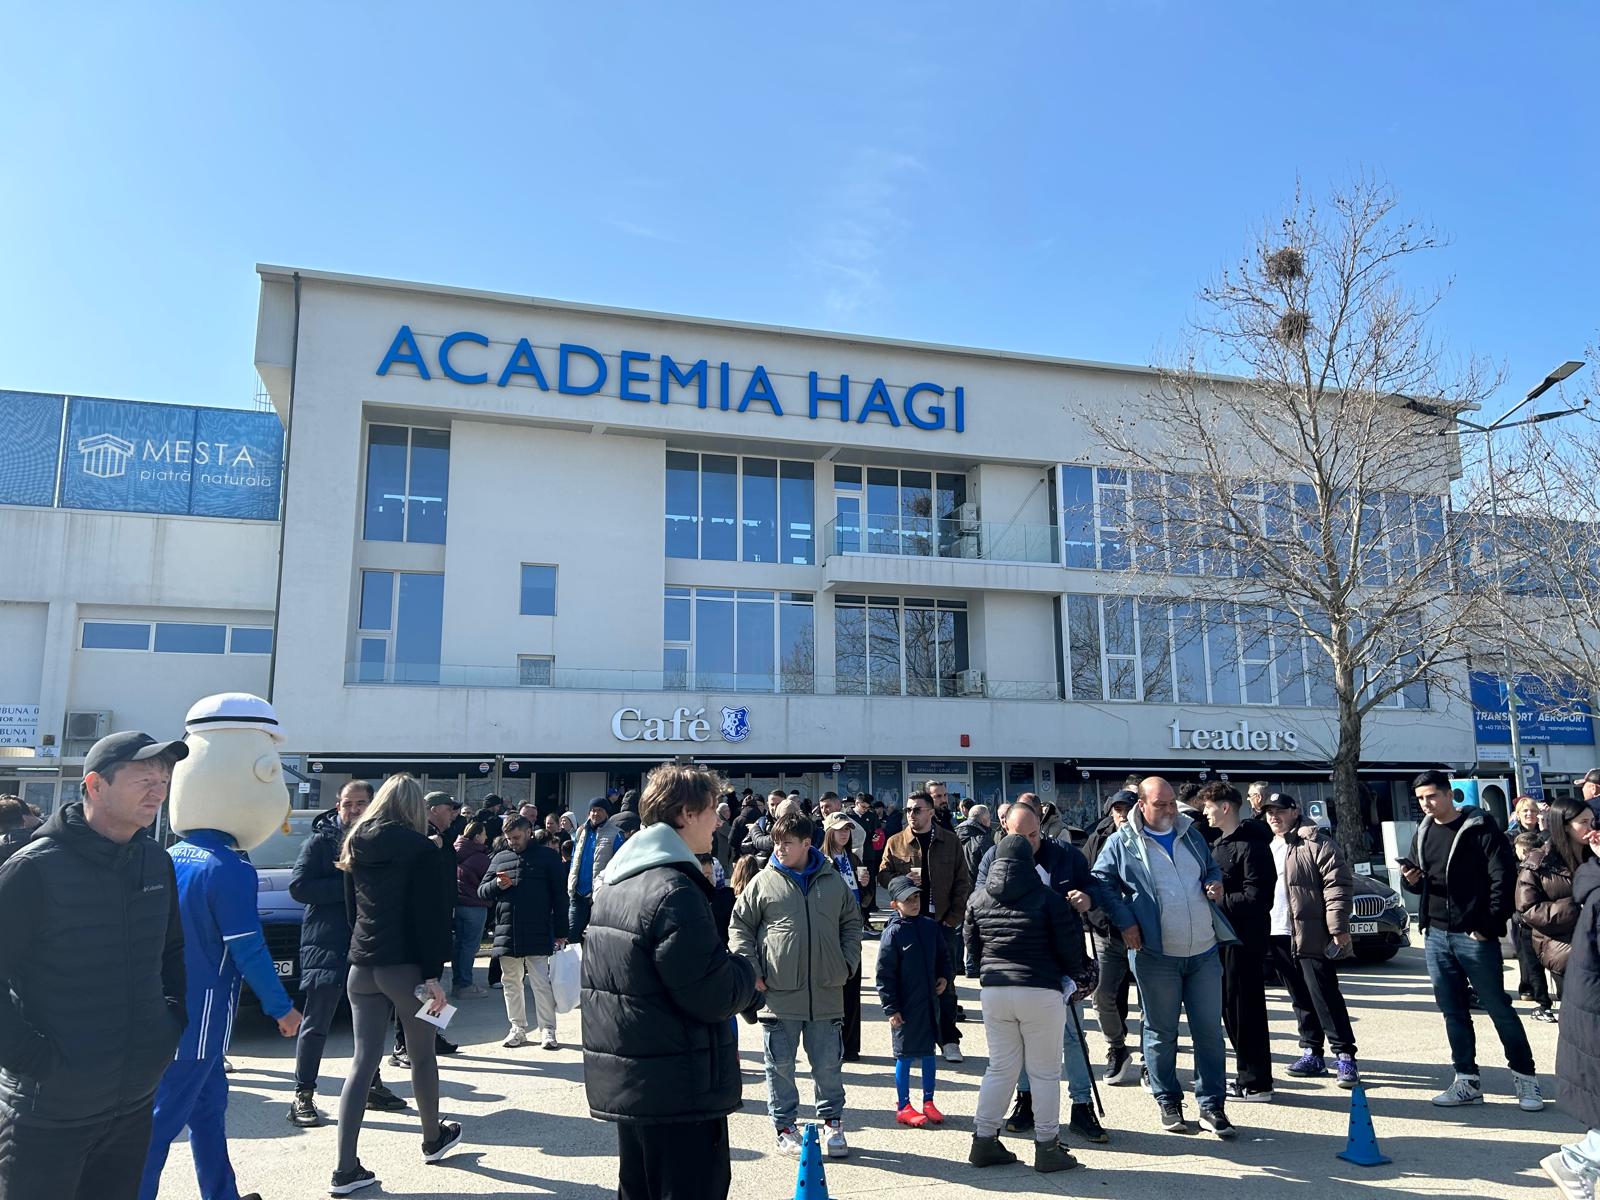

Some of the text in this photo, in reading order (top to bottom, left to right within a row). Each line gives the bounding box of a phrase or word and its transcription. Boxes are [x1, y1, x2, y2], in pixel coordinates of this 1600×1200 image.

[376, 325, 965, 433] ACADEMIA HAGI
[142, 438, 255, 468] MESTA
[611, 706, 711, 742] Café
[1476, 711, 1586, 723] TRANSORT AEROPORT
[1168, 719, 1299, 751] Leaders
[1357, 923, 1374, 933] FCX
